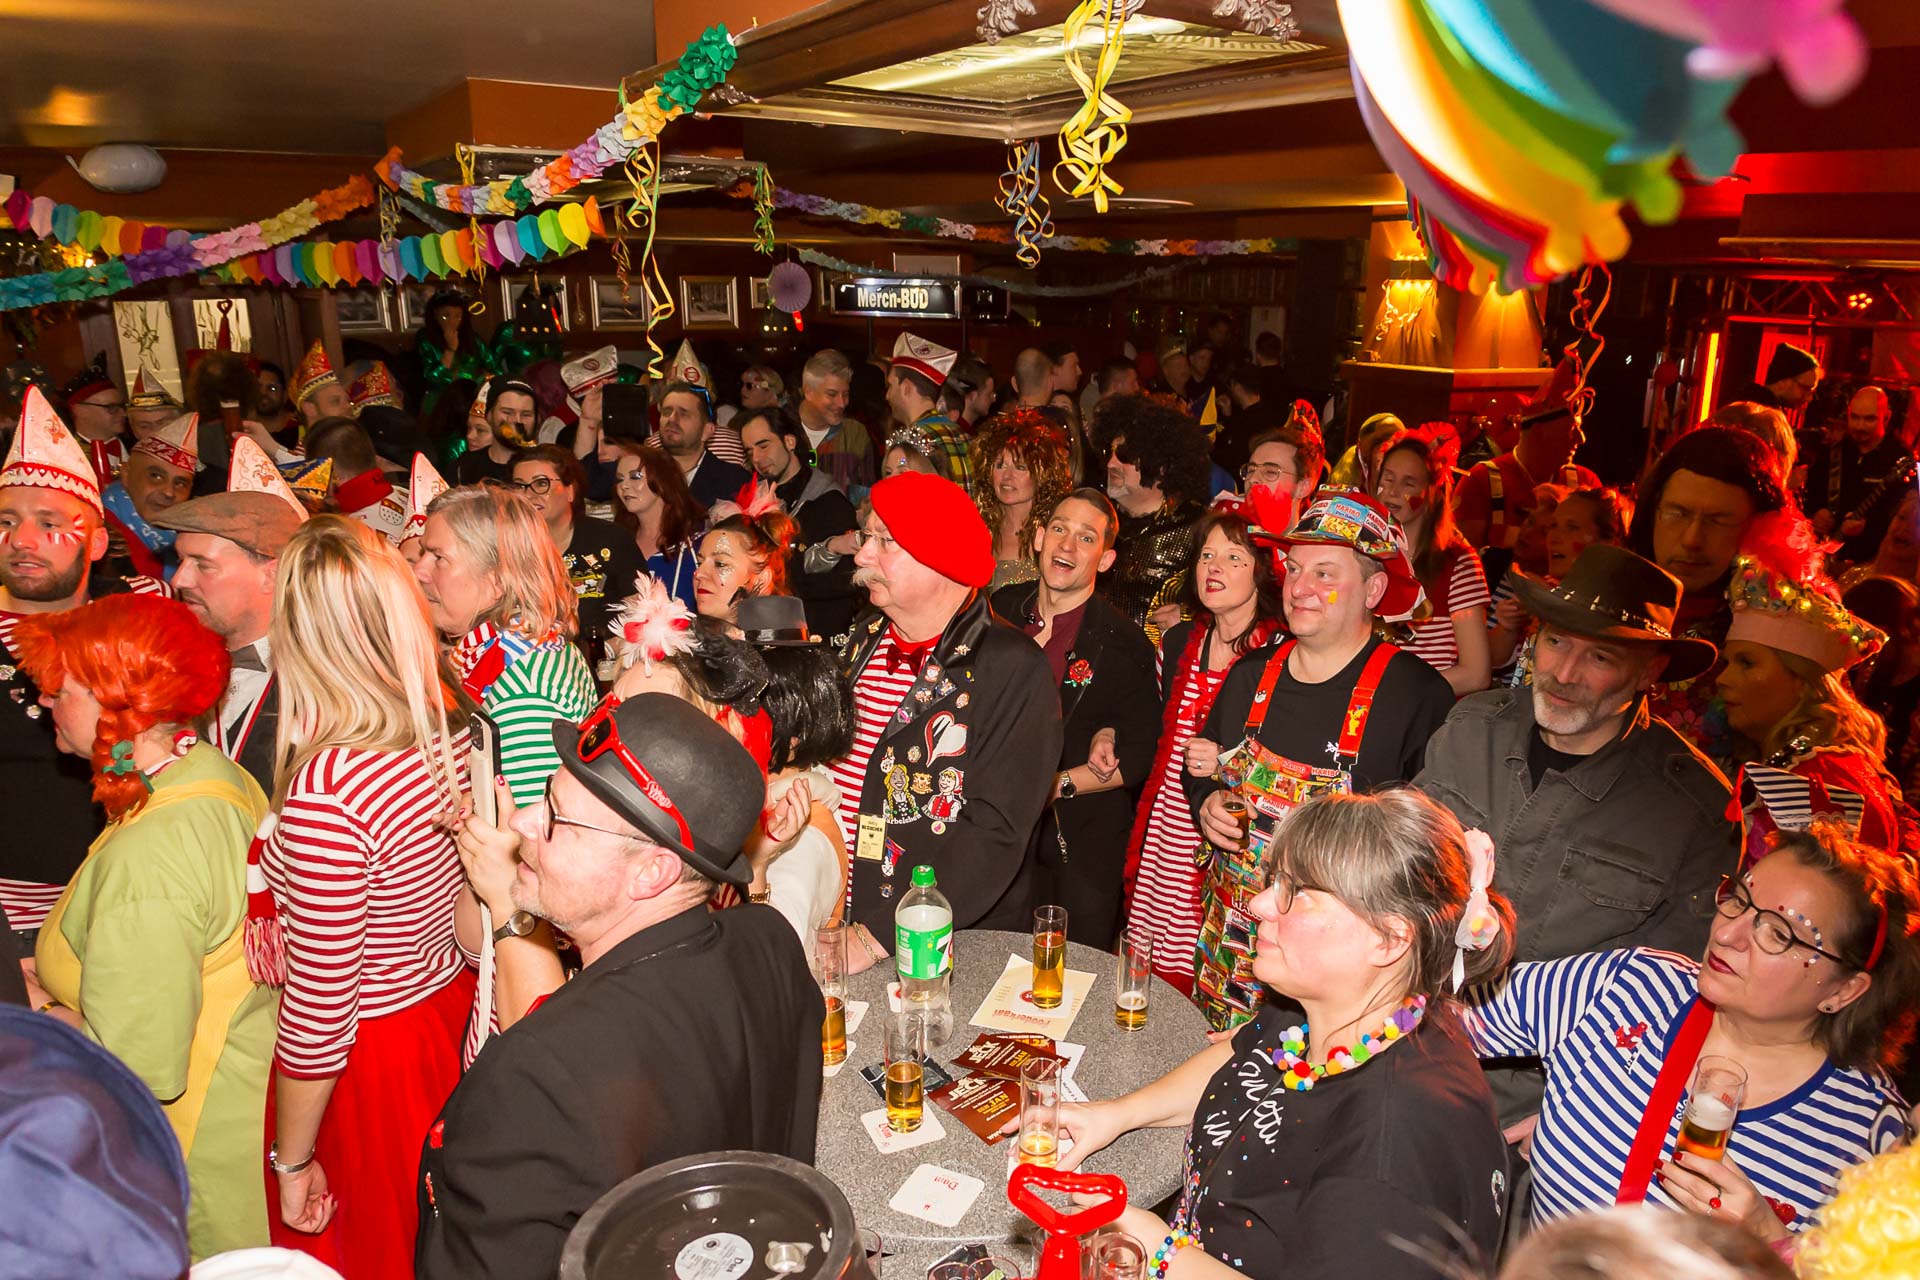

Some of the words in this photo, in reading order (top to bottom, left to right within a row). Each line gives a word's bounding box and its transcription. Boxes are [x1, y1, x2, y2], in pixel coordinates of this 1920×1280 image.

[1335, 503, 1361, 518] HARIBO
[968, 1041, 1000, 1063] JECK
[948, 1078, 987, 1101] JECK
